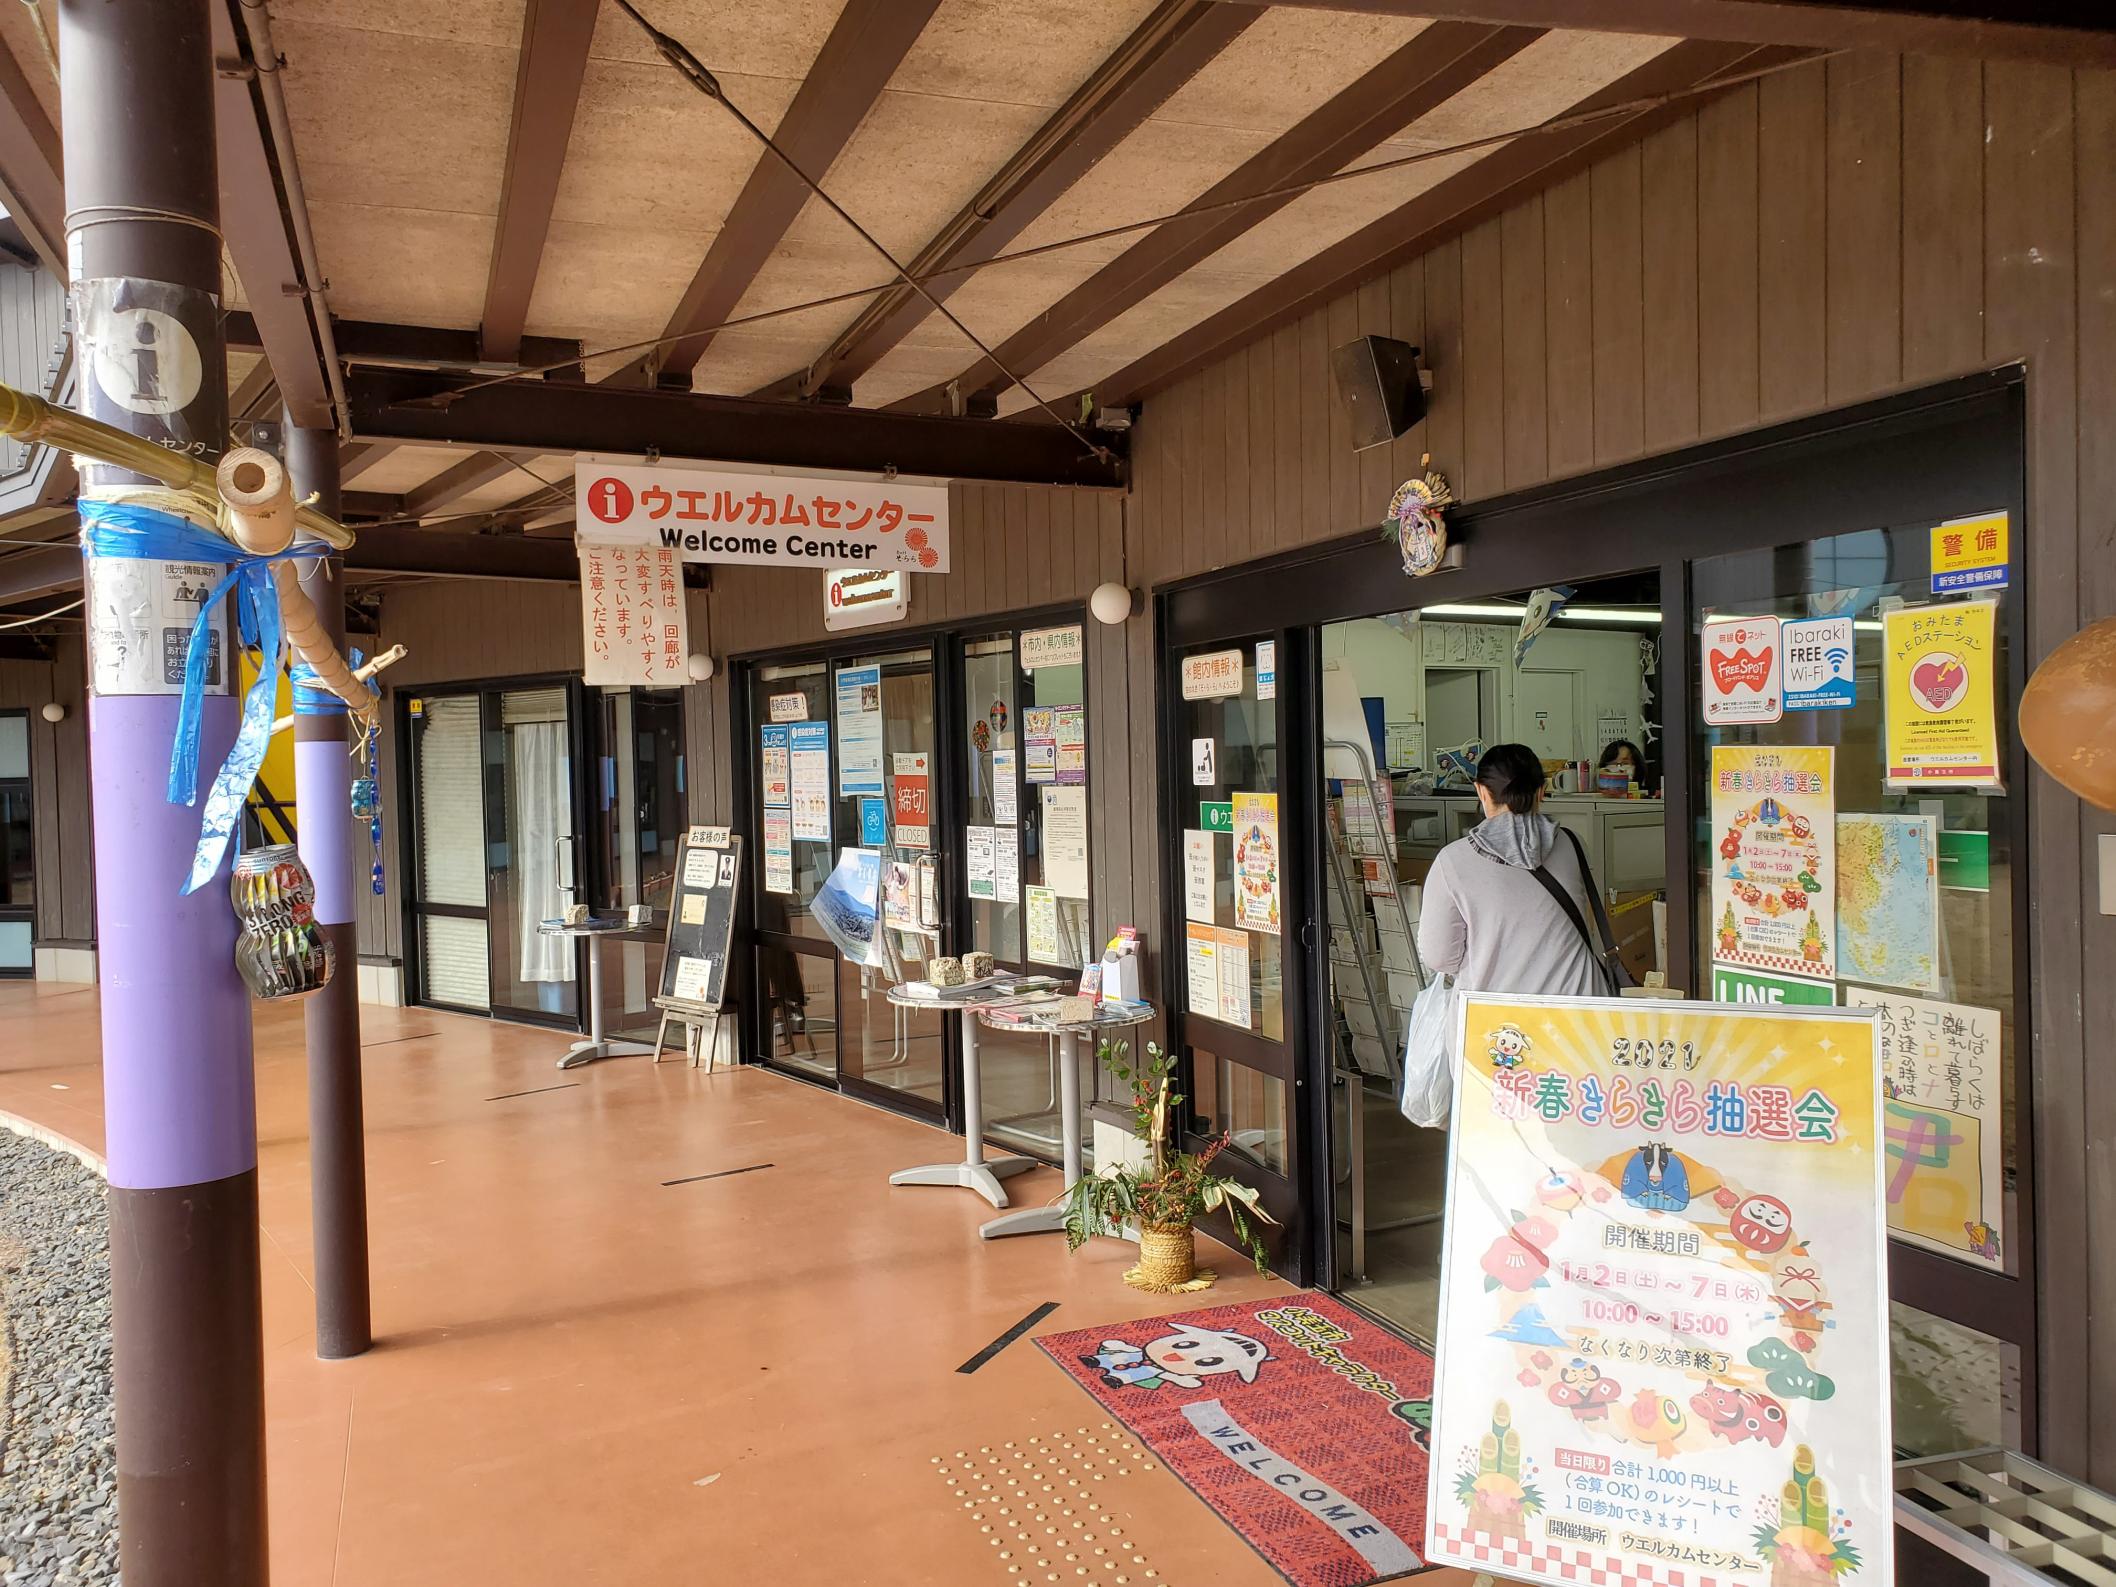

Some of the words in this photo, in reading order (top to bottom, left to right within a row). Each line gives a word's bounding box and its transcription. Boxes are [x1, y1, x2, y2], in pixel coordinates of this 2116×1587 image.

[640, 485, 935, 533] ウエルカムセンター
[659, 527, 777, 555] Welcome
[785, 535, 878, 560] Center
[1942, 528, 1998, 556] 警備
[1939, 569, 2003, 587] 新安全警備保障
[611, 547, 632, 645] なっています。
[635, 547, 656, 681] 大変すべりやすく
[1912, 614, 1965, 631] おみたま
[664, 625, 680, 669] 回廊が
[1790, 623, 1846, 645] Ibaraki
[1790, 646, 1822, 663] FREE
[1790, 664, 1824, 682] Wi-Fi
[1926, 687, 1952, 702] AED
[1720, 770, 1822, 793] 新春きらきら抽選会
[897, 786, 926, 814] 締切
[691, 830, 728, 844] お客様の声
[897, 828, 928, 843] CLOSED
[1612, 1037, 1702, 1072] 2021
[1968, 1018, 1989, 1111] しばらくは
[1496, 1069, 1838, 1142] 新春きらきら抽選会
[1604, 1224, 1700, 1256] 開催期間
[1258, 1310, 1401, 1401] マスコットキャラクター
[1579, 1335, 1731, 1374] なくなり次第終了
[1559, 1452, 1607, 1473] 当日限り
[1209, 1425, 1379, 1540] WELCOME
[1549, 1518, 1608, 1546] 開催場所
[1621, 1534, 1761, 1571] ウエルカムセンター
